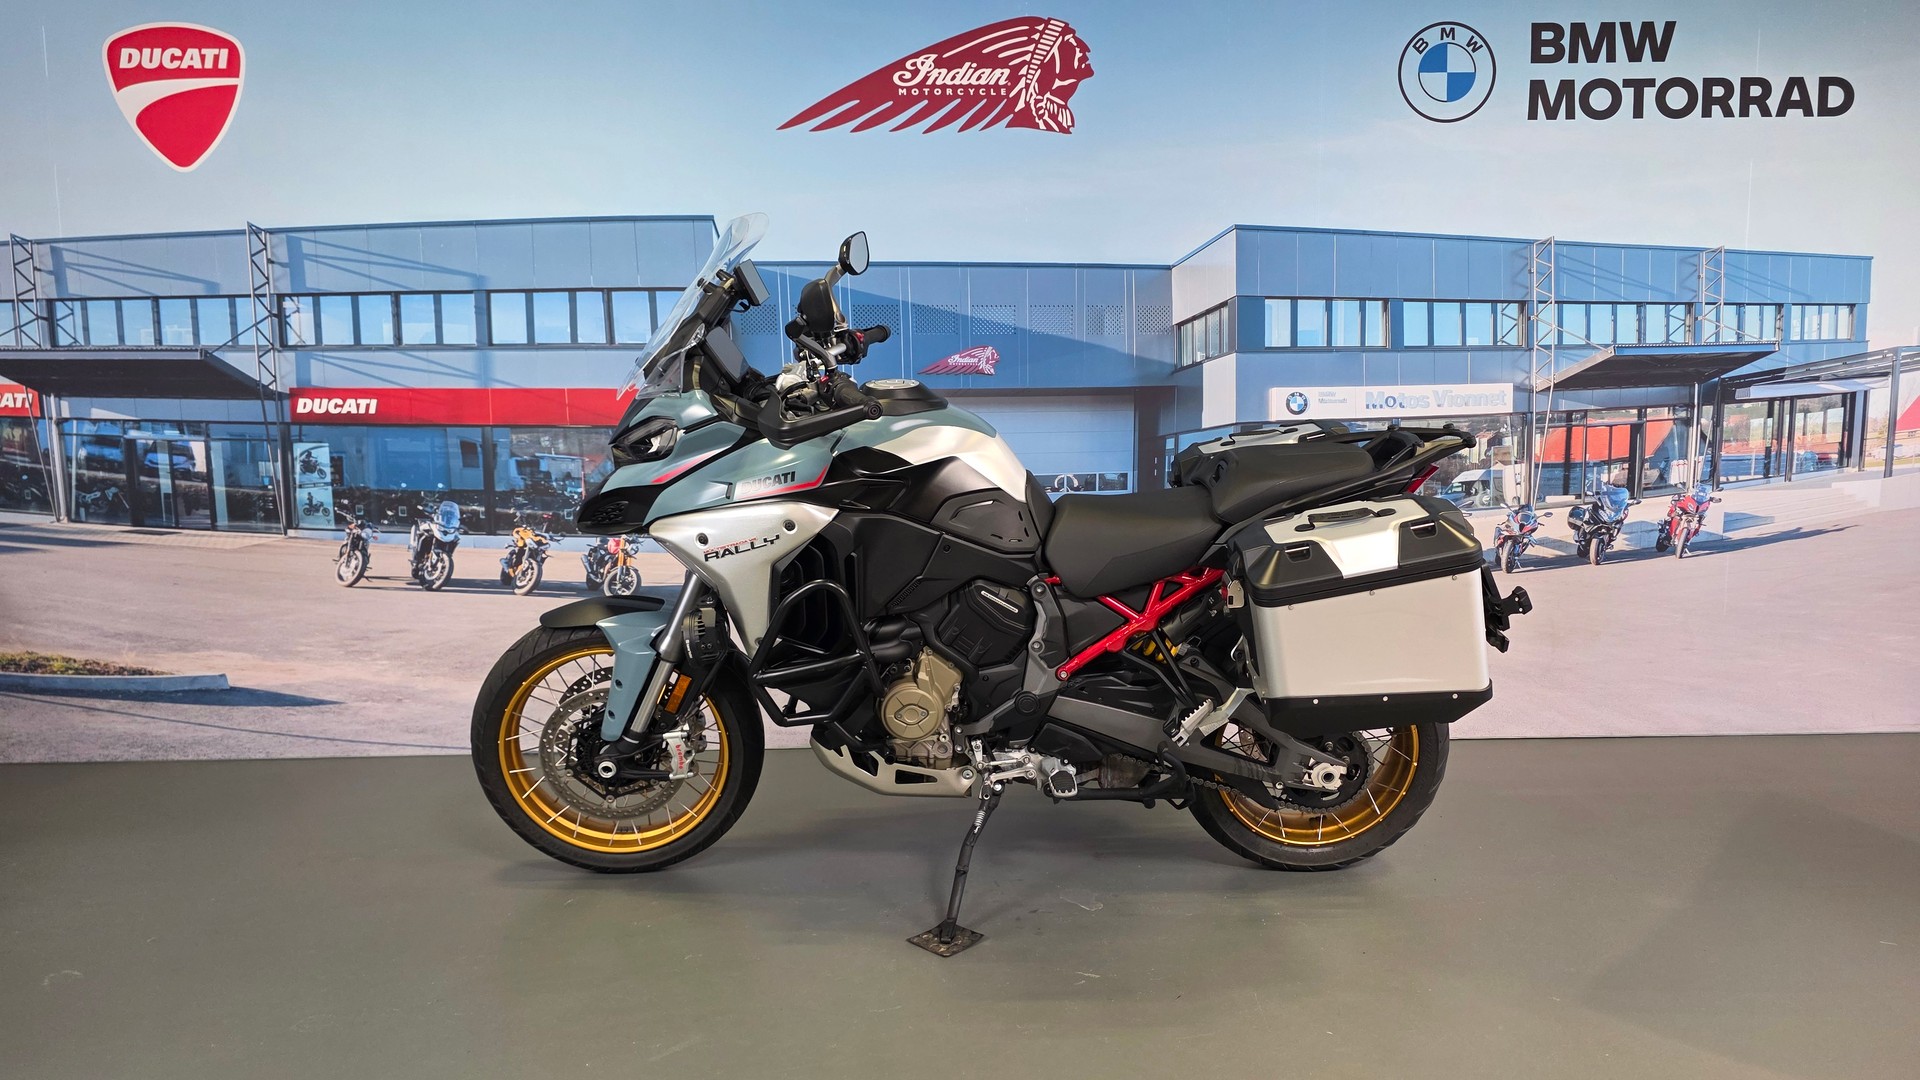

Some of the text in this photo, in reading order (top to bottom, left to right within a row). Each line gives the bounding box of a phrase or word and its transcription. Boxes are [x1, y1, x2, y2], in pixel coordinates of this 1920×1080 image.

[1411, 26, 1483, 55] BMW
[1530, 20, 1677, 64] BMW
[119, 47, 229, 69] DUCATI
[892, 53, 1010, 87] Indian
[898, 88, 1007, 96] MOTORCYCLE
[1527, 75, 1856, 121] MOTORRAD
[0, 392, 33, 408] ATI
[296, 397, 378, 414] DUCATI
[1365, 389, 1507, 409] Motos Vionnet
[741, 471, 796, 494] DUCATI
[704, 534, 780, 562] RALLY
[675, 744, 685, 769] brembo
